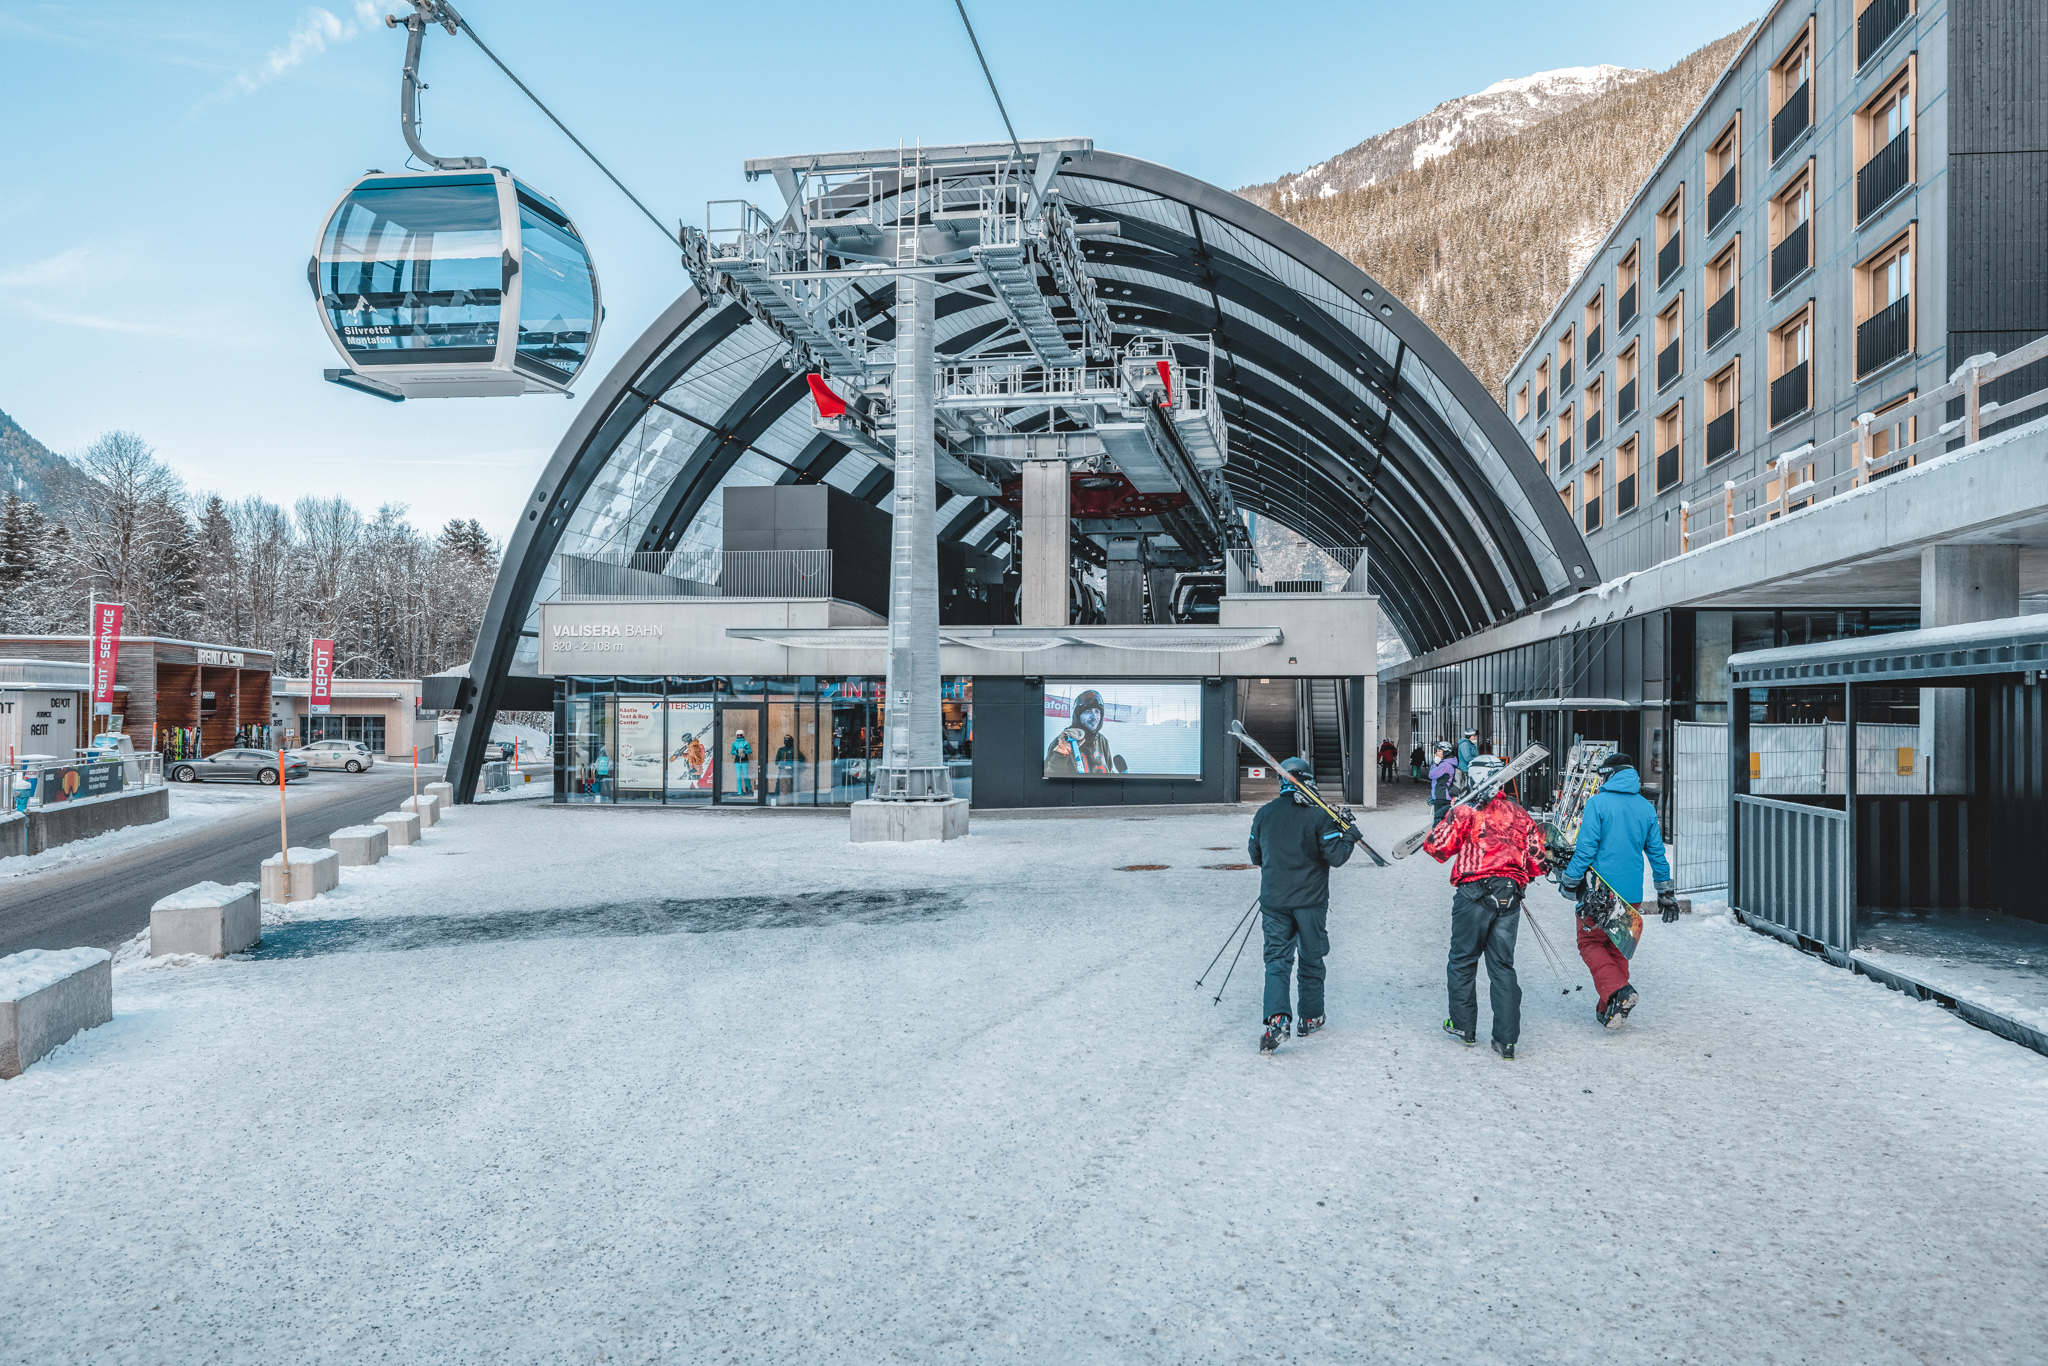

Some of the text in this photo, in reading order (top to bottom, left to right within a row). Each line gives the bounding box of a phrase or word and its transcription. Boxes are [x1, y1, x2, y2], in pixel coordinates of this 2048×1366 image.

[344, 326, 391, 335] Silvretta
[346, 336, 392, 345] Montafon
[100, 609, 115, 658] SERVICE
[553, 625, 663, 637] VALISERA BAHN
[553, 642, 572, 652] 820
[582, 642, 611, 652] 2.108
[613, 643, 623, 651] m
[198, 649, 244, 667] RENT A SKI
[315, 648, 329, 697] DEPOT
[97, 667, 108, 698] RENT
[51, 698, 70, 708] DEPOT
[31, 724, 48, 735] RENT
[1406, 830, 1426, 845] HEAD
